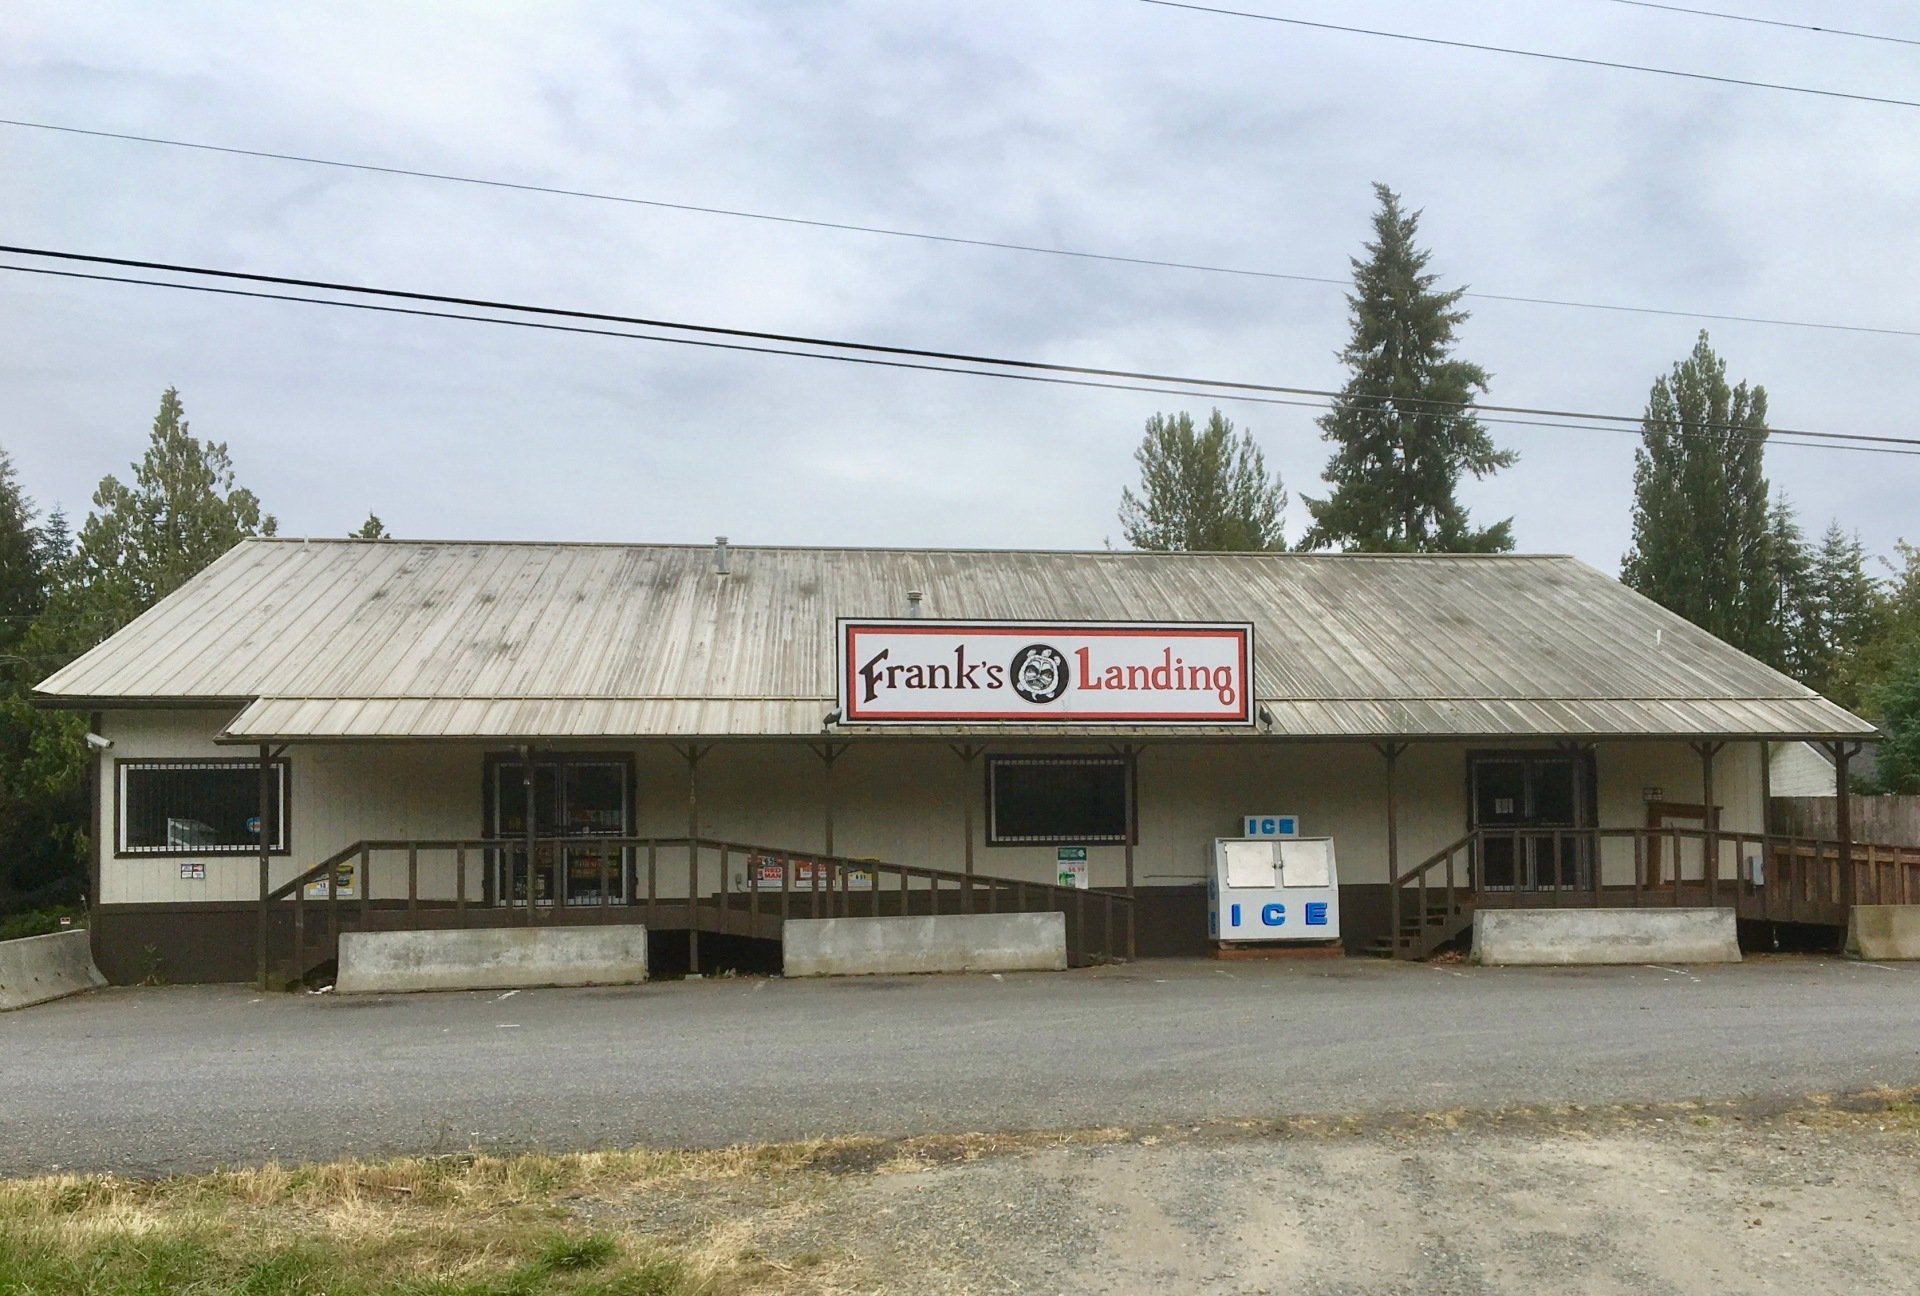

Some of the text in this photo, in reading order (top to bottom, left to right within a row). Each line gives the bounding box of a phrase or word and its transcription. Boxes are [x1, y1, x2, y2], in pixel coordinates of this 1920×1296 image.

[858, 644, 1236, 706] Frank's Landing
[1249, 818, 1294, 834] ICE
[1231, 902, 1328, 927] ICE
